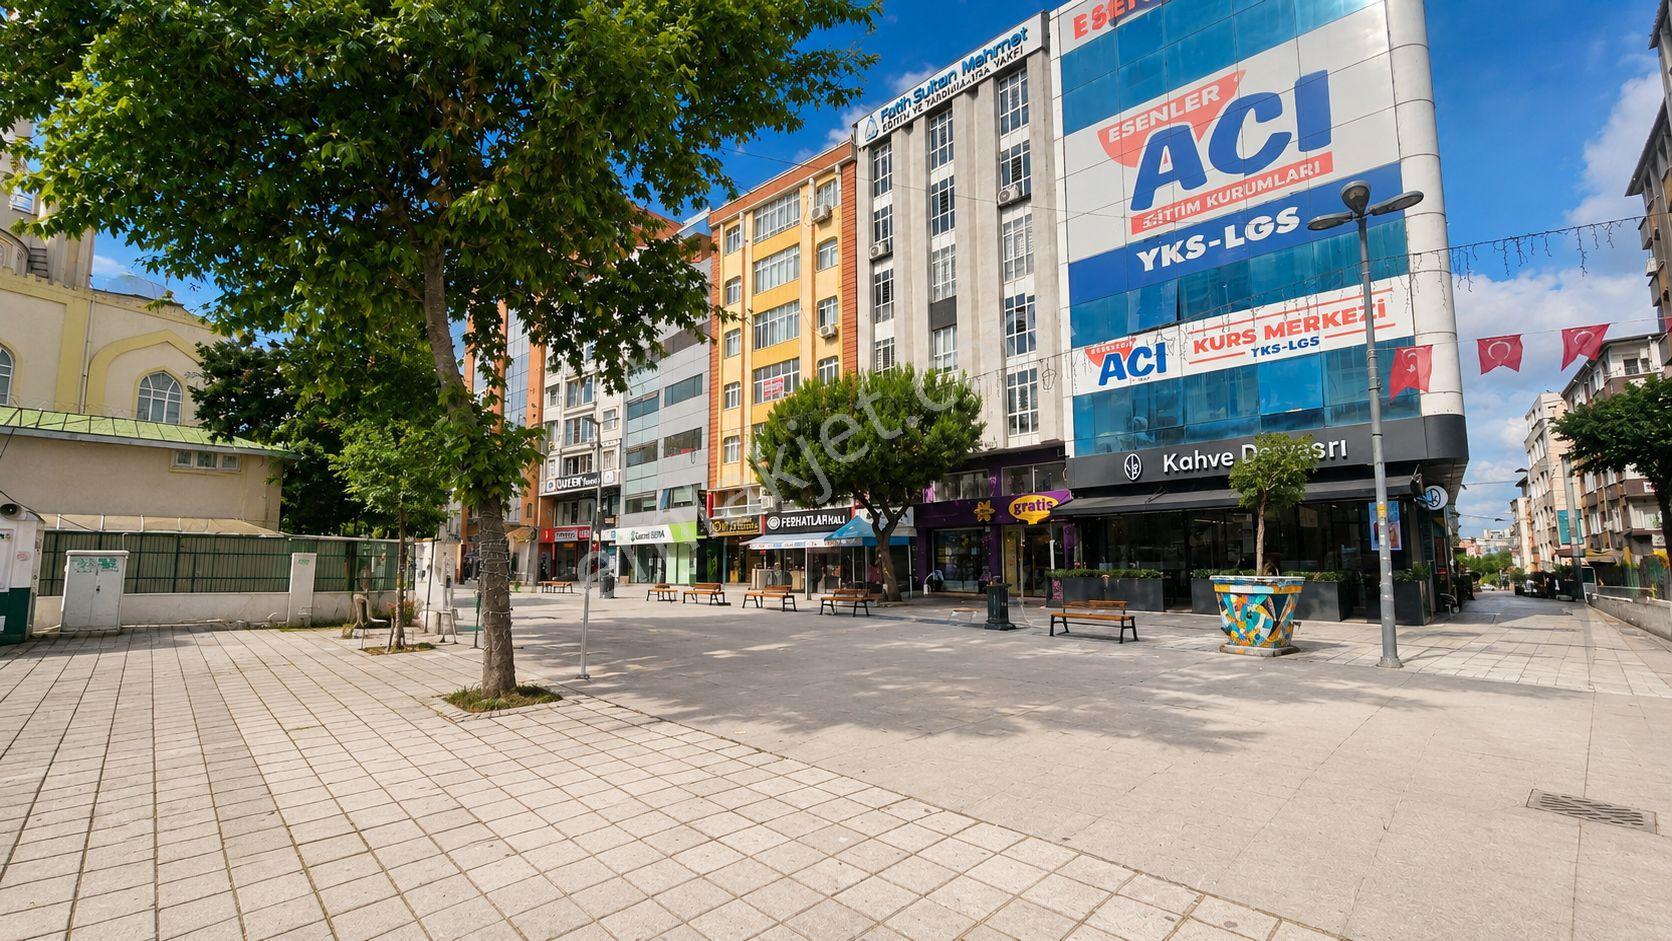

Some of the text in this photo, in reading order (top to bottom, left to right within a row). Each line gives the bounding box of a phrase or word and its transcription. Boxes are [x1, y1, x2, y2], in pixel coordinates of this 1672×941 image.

[913, 69, 958, 104] Sultan
[1108, 83, 1221, 144] ESENLER
[1130, 69, 1332, 211] ACI
[1206, 160, 1321, 208] KURUMLARI
[1136, 206, 1300, 272] YKS-LGS
[1193, 298, 1387, 354] KURS MERKEZİ
[1251, 336, 1320, 358] YKS-LGS
[1163, 449, 1234, 474] Kahve
[1013, 498, 1053, 516] gratis
